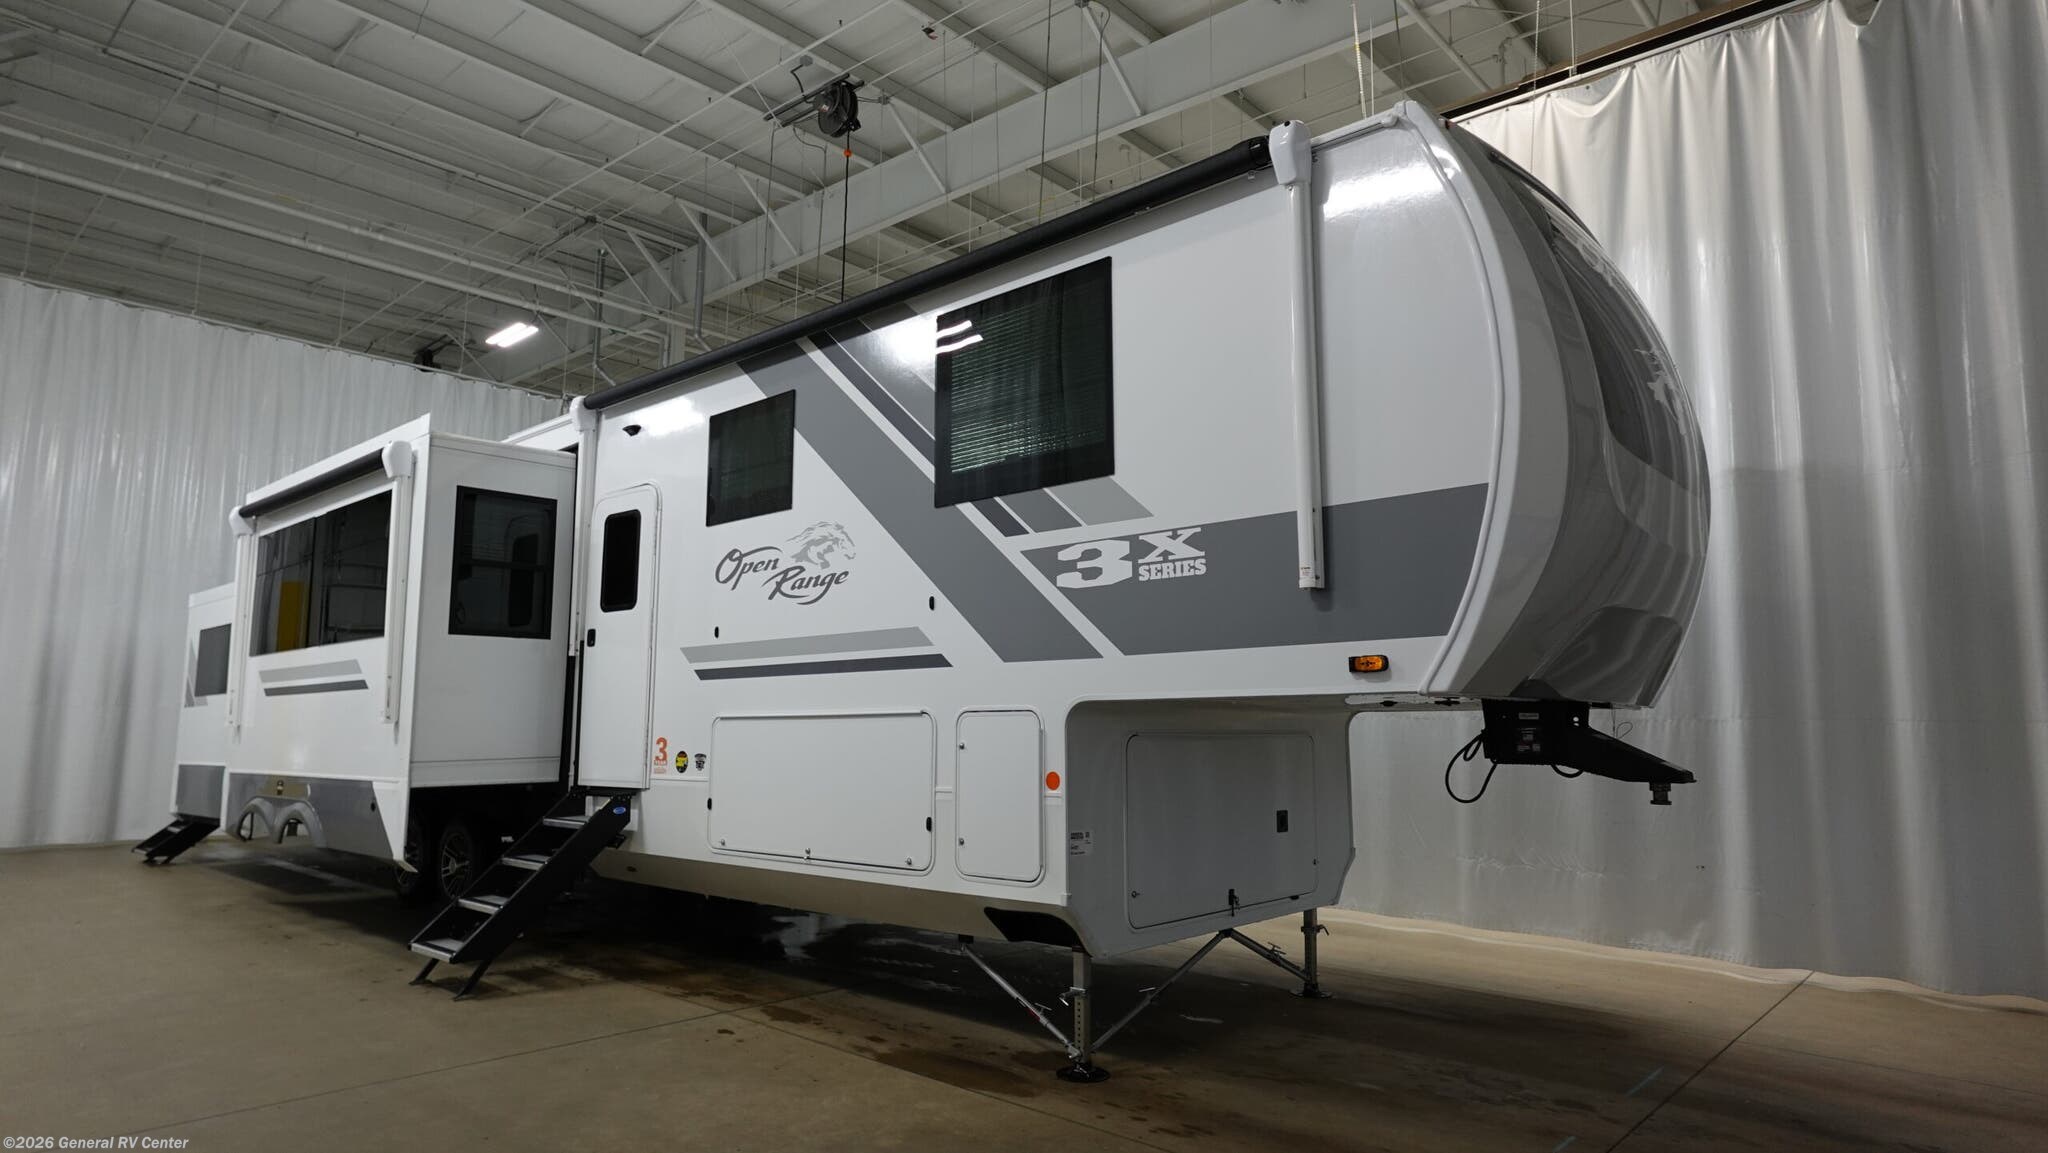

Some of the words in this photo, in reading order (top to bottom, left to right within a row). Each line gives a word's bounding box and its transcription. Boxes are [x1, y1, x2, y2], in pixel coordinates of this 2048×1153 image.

[715, 546, 783, 591] Open
[1056, 539, 1133, 589] 3
[1138, 527, 1206, 564] X
[1138, 558, 1207, 582] SERIES
[761, 565, 849, 605] Range
[655, 737, 668, 761] 3
